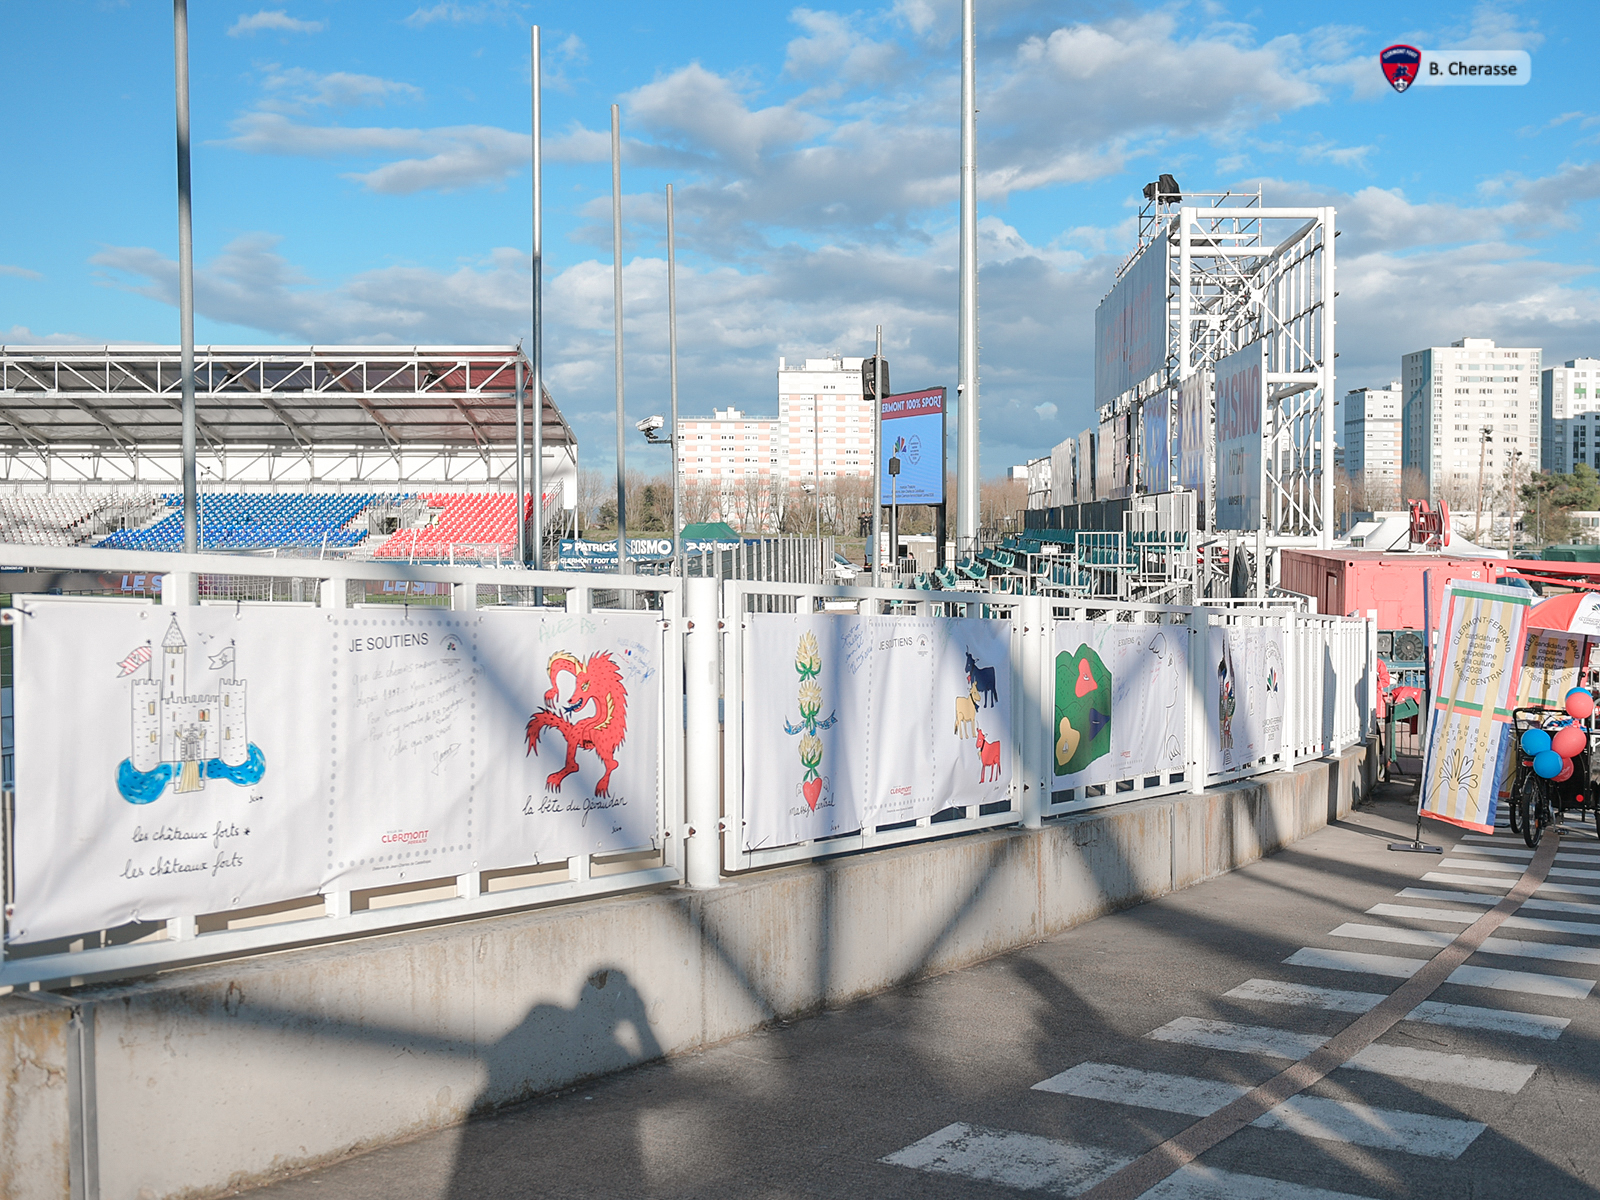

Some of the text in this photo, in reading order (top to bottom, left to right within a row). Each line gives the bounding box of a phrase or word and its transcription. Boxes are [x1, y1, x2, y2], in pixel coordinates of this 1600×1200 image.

[882, 395, 942, 414] ERMONT 100% SPORT
[1216, 363, 1260, 443] CASINO
[575, 539, 673, 555] PATRICK COSMO
[699, 542, 741, 552] PARICK
[348, 638, 363, 653] JE
[366, 632, 429, 651] SOUTIENS
[1453, 616, 1511, 654] CLERMONT-FERRAND
[1534, 641, 1570, 652] candidature
[1538, 648, 1563, 657] capitale
[1472, 659, 1496, 669] culture
[1531, 654, 1568, 665] européenne
[1466, 665, 1483, 675] 2028
[1470, 667, 1506, 686] CENTRAL
[522, 795, 535, 816] la
[537, 795, 564, 814] bête
[565, 800, 581, 812] du
[131, 820, 240, 849] les châteaux forts
[119, 850, 244, 880] les châteaux forts
